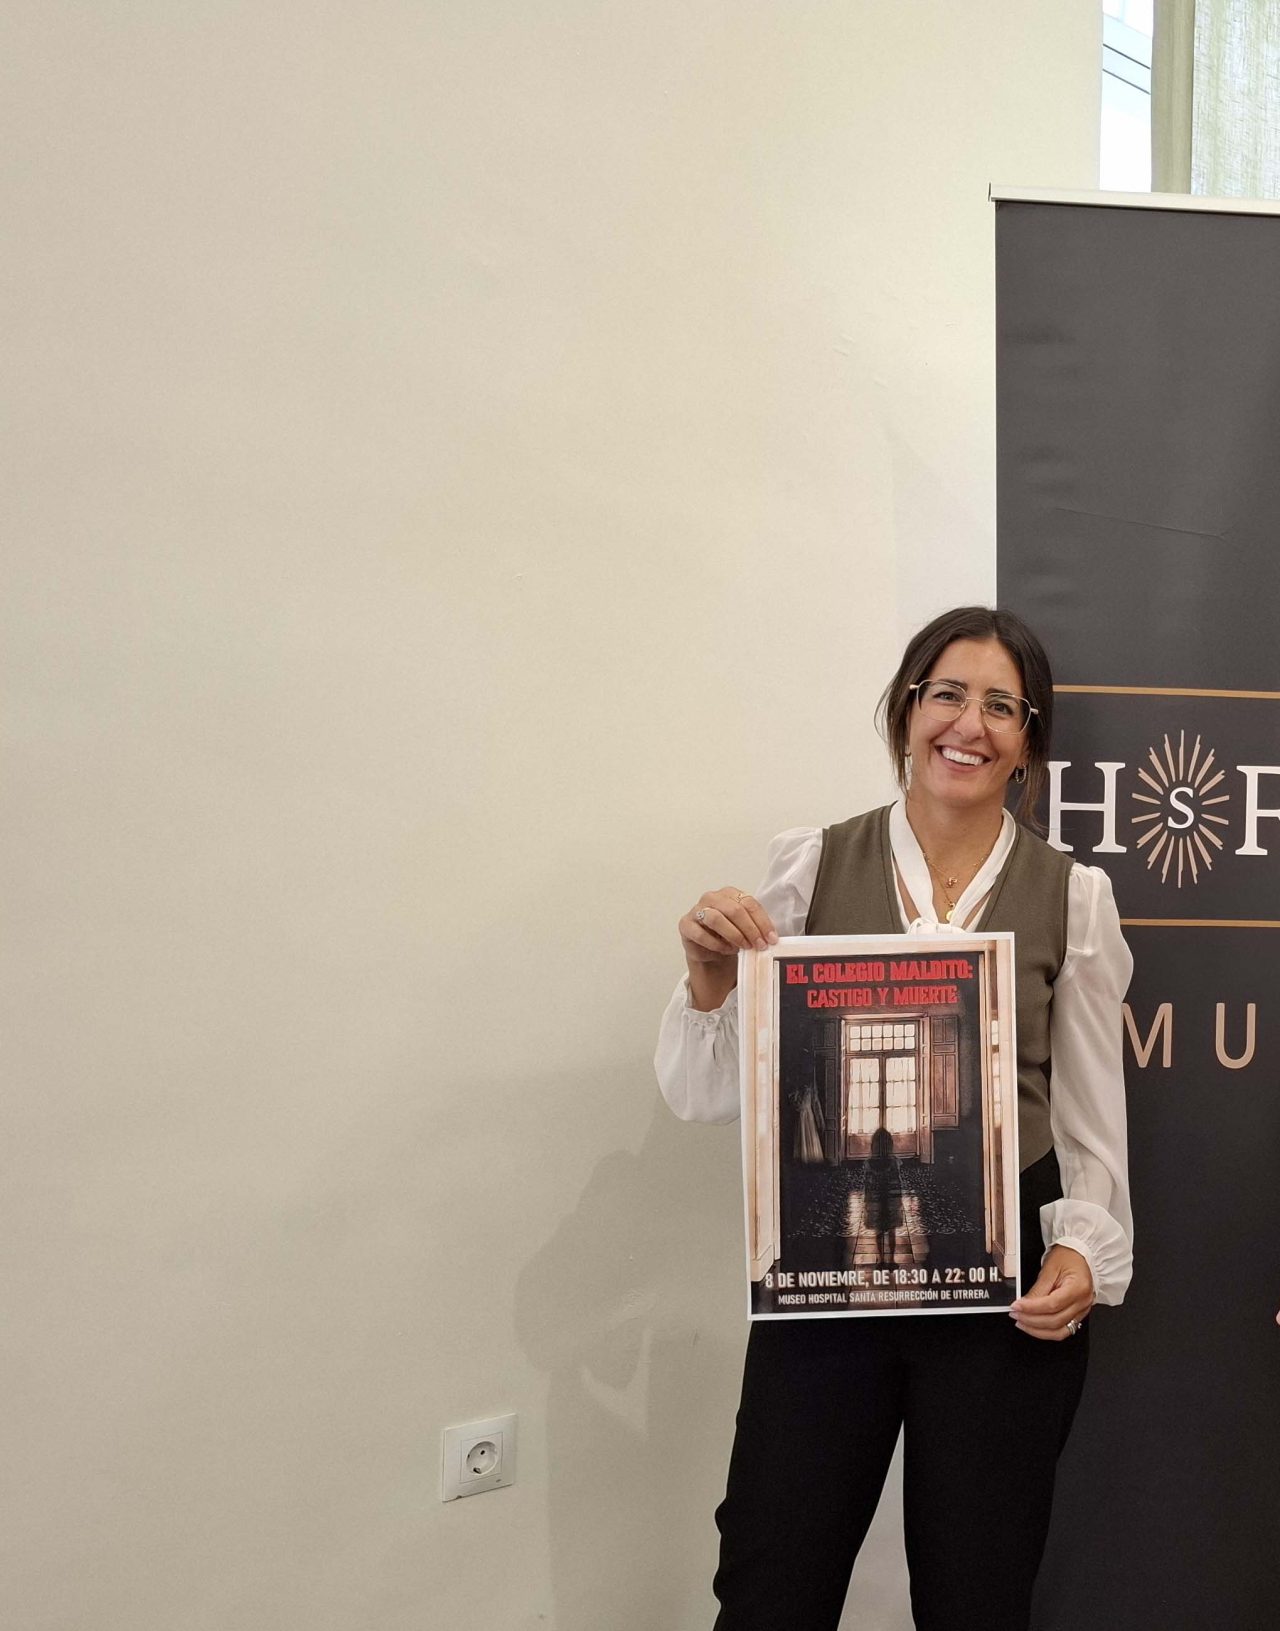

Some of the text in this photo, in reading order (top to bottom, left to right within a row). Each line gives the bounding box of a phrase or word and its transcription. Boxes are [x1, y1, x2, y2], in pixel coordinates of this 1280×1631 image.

[786, 959, 974, 984] EL COLEGIO MALDITO:
[807, 985, 958, 1008] CASTIGO Y MUERTE
[765, 1266, 1003, 1289] 8 DE NOVIEMRE, DE 18:30 A 22: 00 H.
[778, 1288, 990, 1305] MUSEO HOSPITAL SANTA RESURRECCIÓN DE UTRRERA
